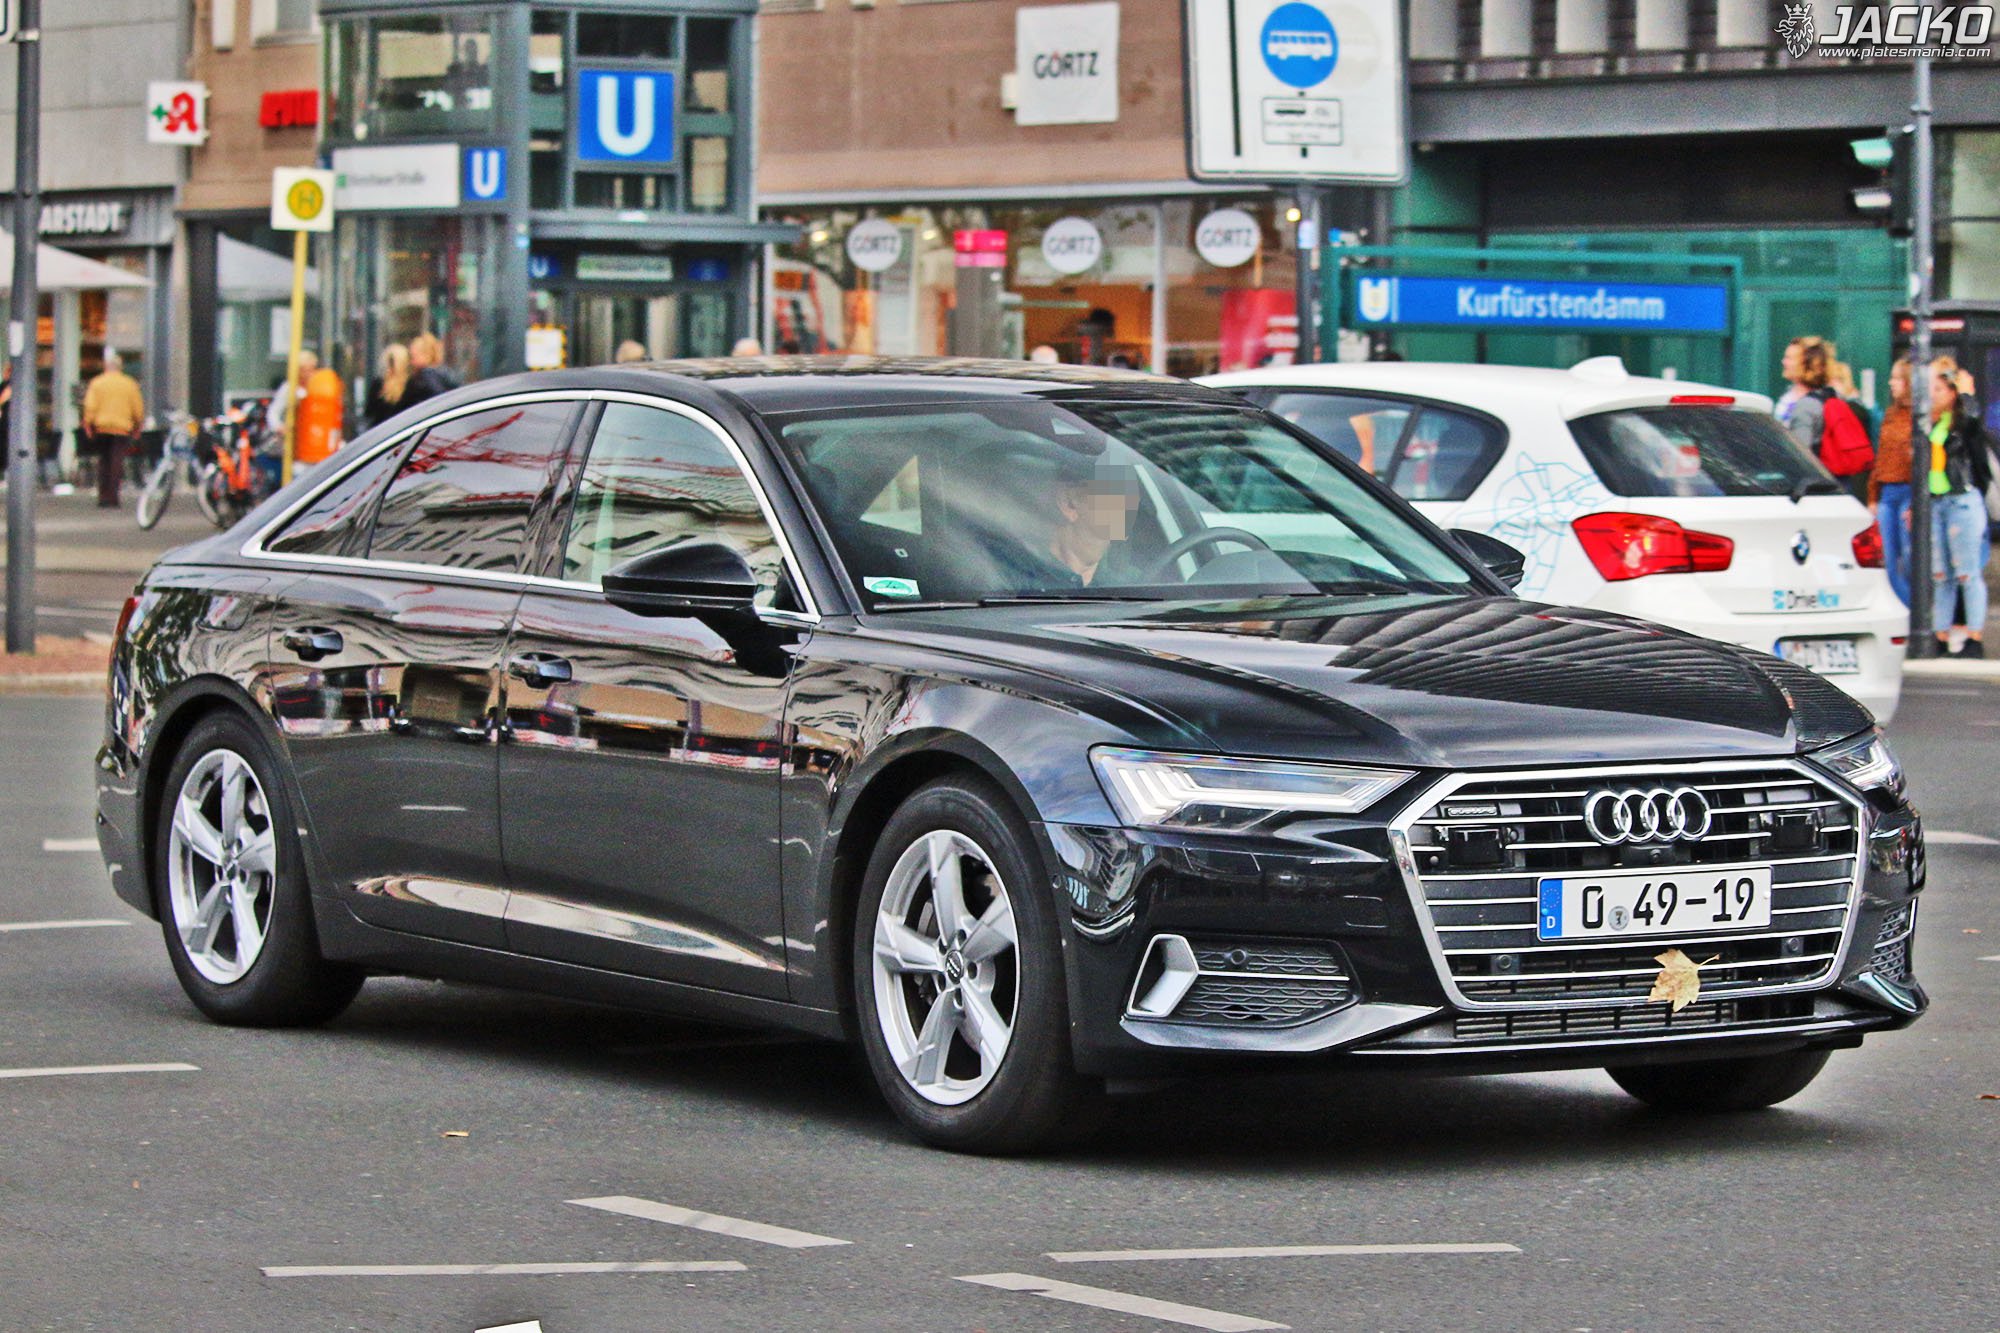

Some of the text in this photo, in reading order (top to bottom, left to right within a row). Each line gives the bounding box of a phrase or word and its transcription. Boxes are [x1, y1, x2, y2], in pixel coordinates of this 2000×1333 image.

[1033, 51, 1099, 79] GÖRTZ
[597, 75, 655, 156] U
[472, 151, 500, 198] U
[39, 203, 121, 233] ARSTADT
[1457, 285, 1666, 320] Kurfürstendamm
[1633, 877, 1754, 926] 49-19
[1546, 916, 1556, 929] D
